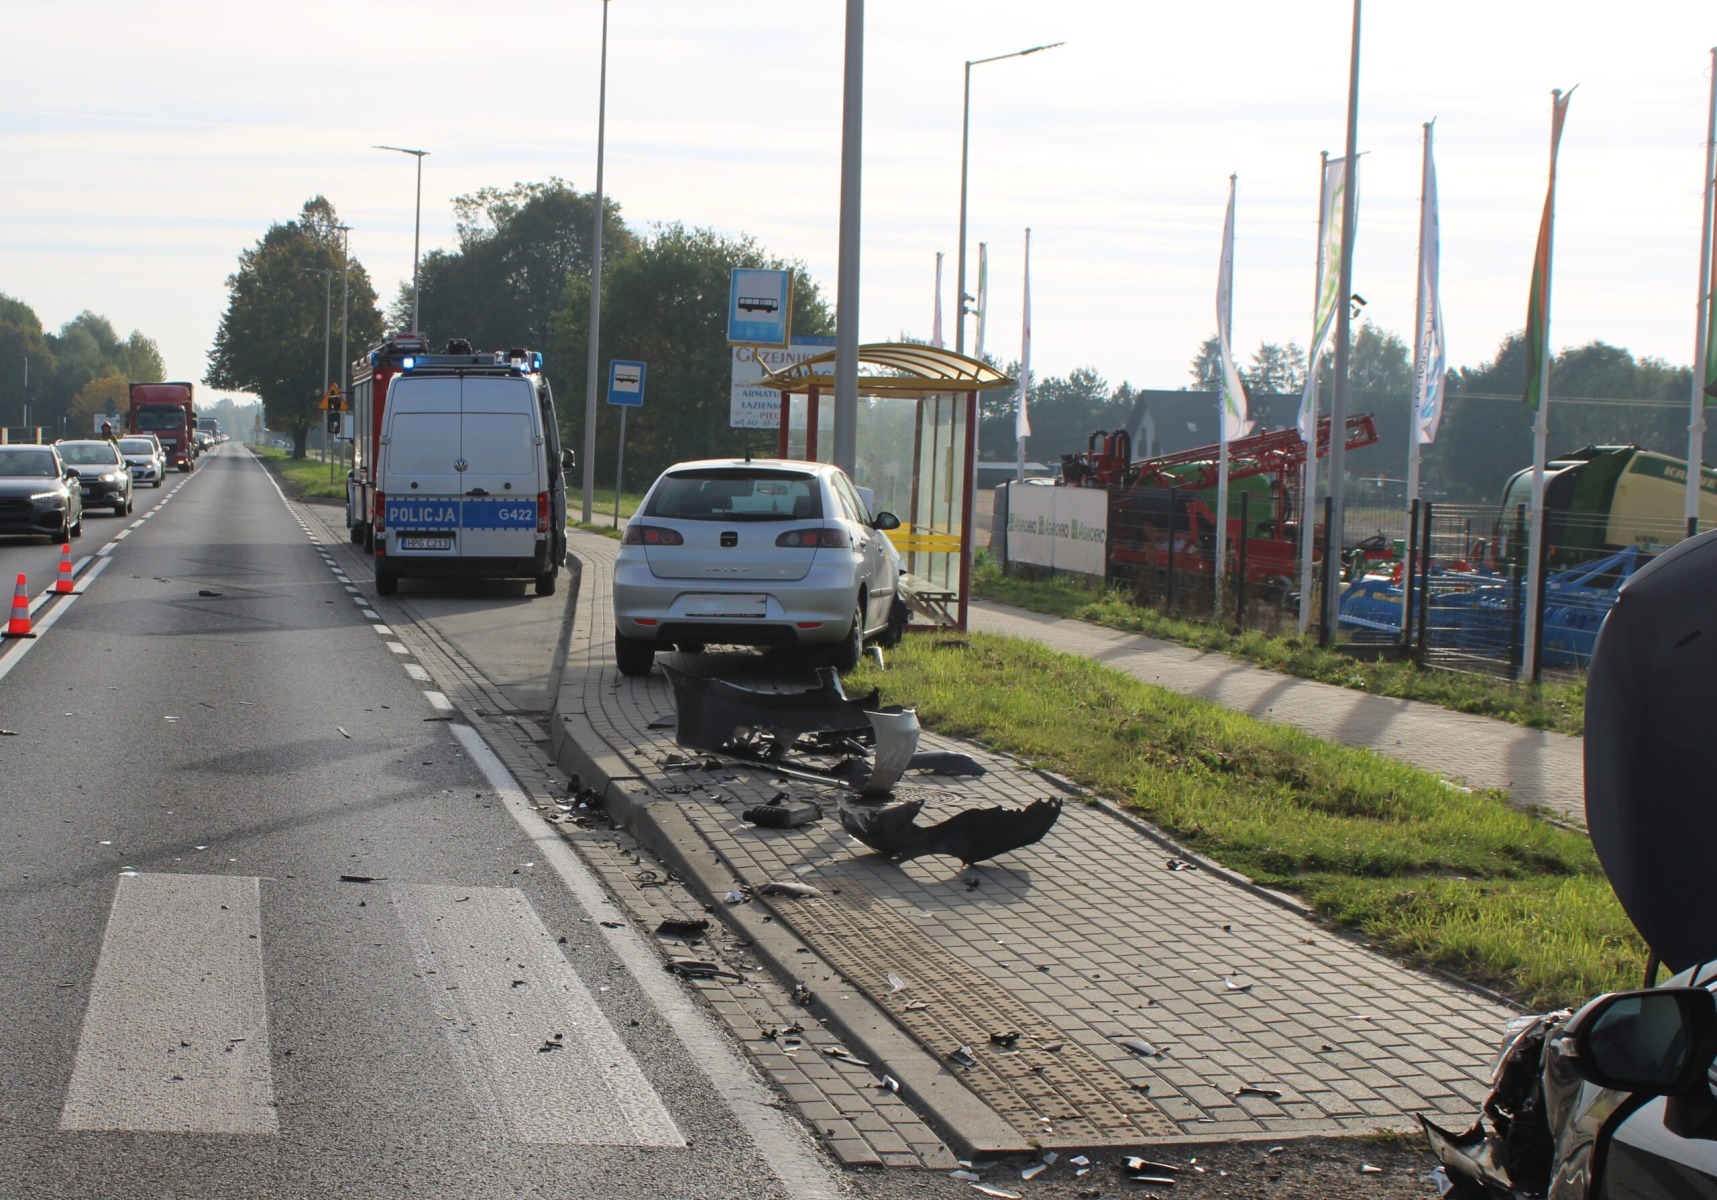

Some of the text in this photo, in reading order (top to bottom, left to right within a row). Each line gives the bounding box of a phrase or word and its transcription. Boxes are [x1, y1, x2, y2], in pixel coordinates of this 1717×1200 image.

[735, 346, 816, 363] GZEJNIK
[1663, 465, 1717, 489] KRNE
[389, 507, 456, 522] POLICJA
[498, 508, 532, 520] G422
[407, 539, 426, 548] HPG
